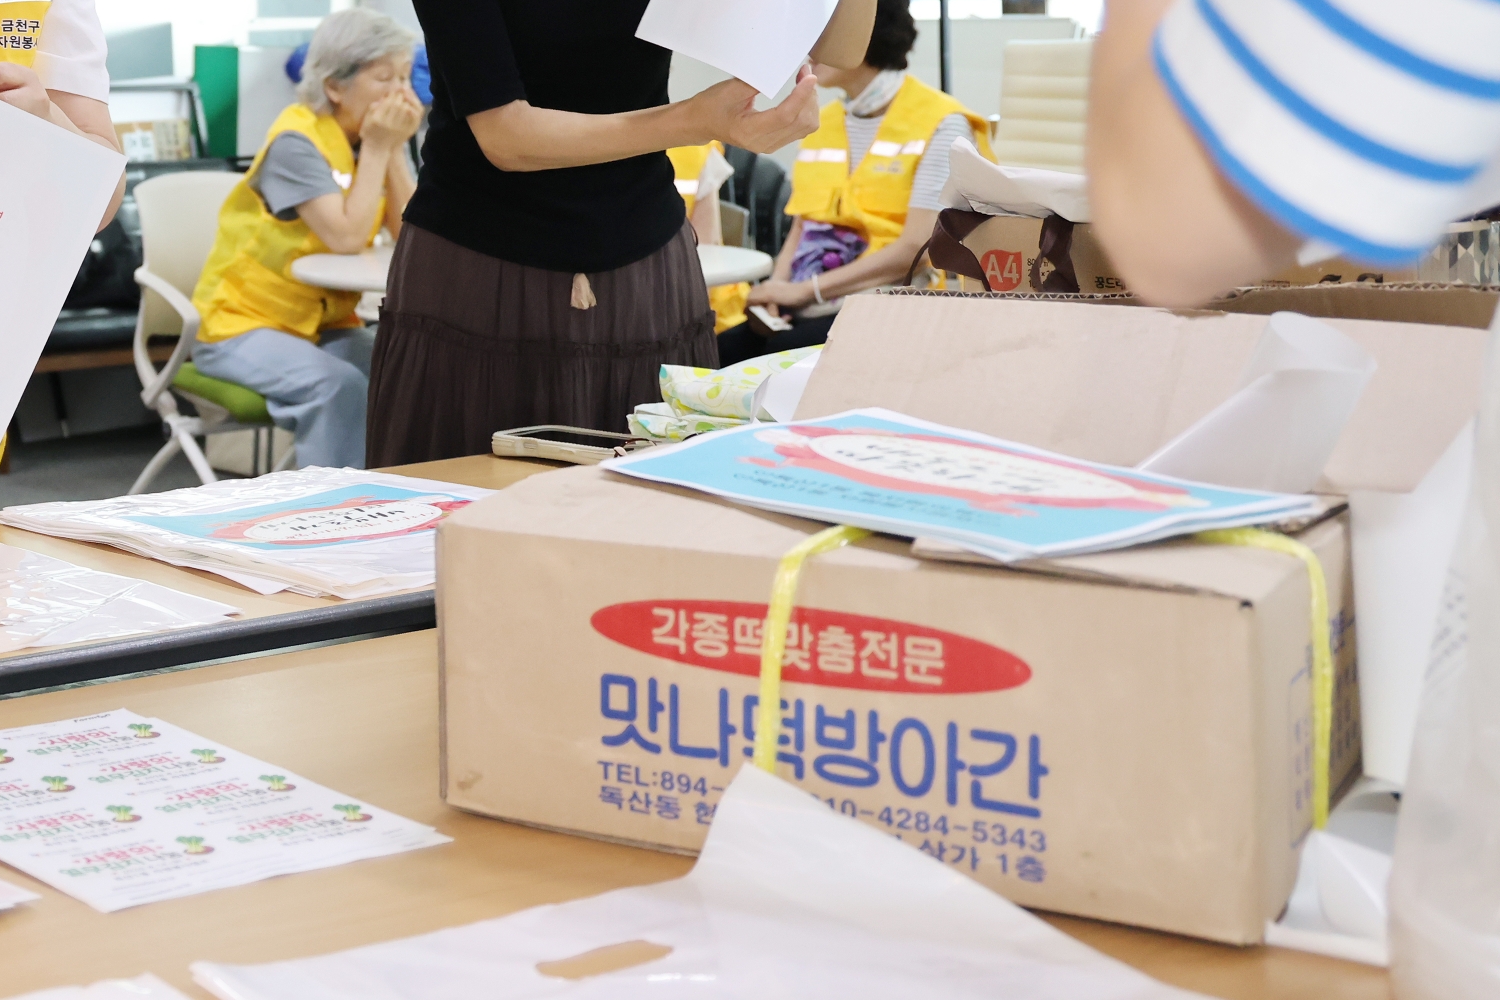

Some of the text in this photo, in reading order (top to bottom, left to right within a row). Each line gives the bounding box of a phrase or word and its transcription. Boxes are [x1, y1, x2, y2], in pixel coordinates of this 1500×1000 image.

[1, 19, 41, 33] 금천구
[986, 254, 1020, 284] A4
[41, 730, 114, 746] 사랑의
[598, 760, 1048, 852] TEL:894- 10-4284-5343
[599, 786, 681, 820] 독산동
